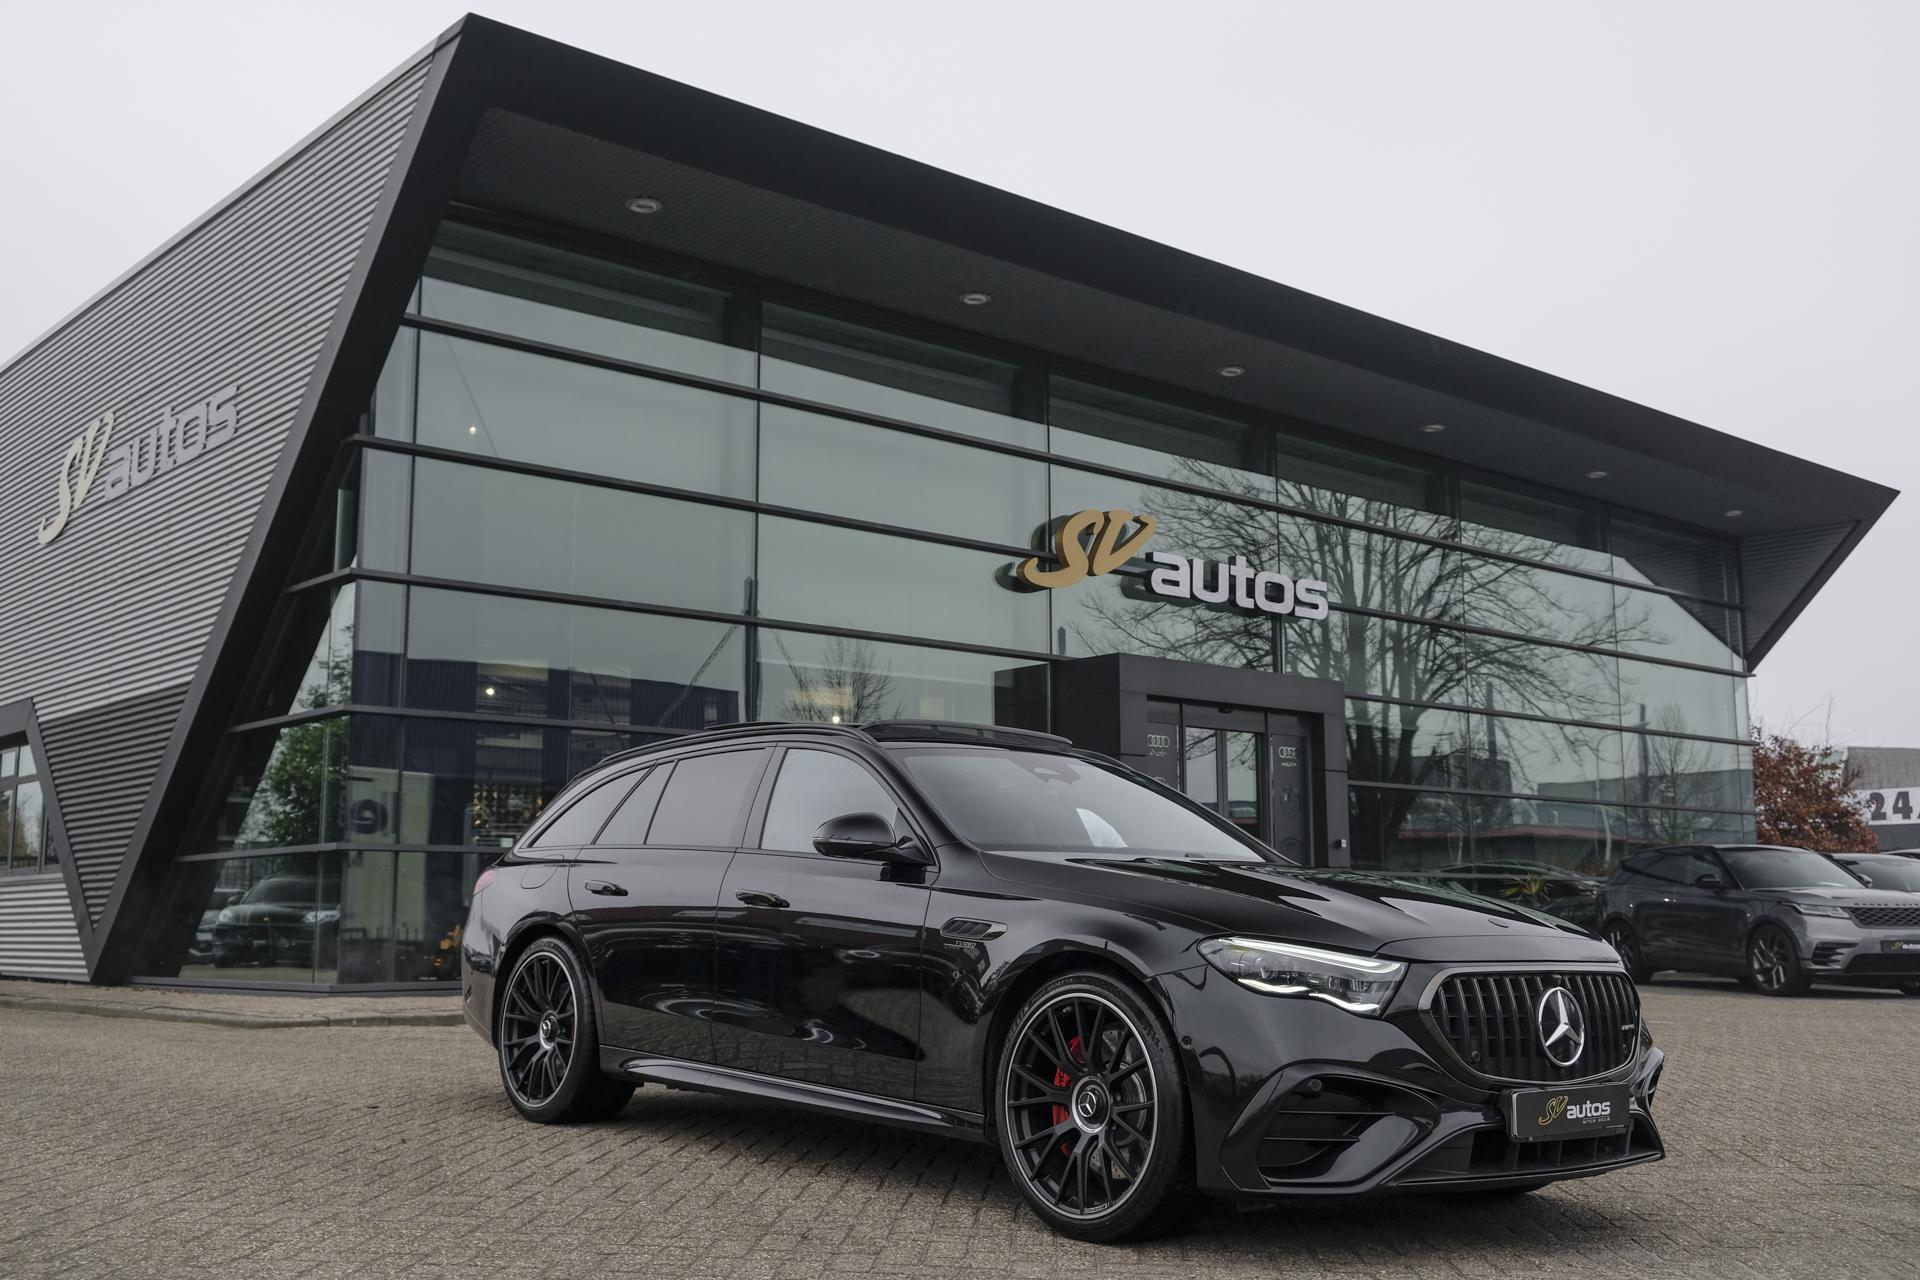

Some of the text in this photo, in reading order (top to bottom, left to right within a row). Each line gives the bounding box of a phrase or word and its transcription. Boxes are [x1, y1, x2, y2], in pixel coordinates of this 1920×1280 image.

[37, 382, 239, 545] SV autos
[1017, 508, 1329, 621] SV autos
[1869, 791, 1920, 821] 24
[1538, 1095, 1611, 1126] SV autos
